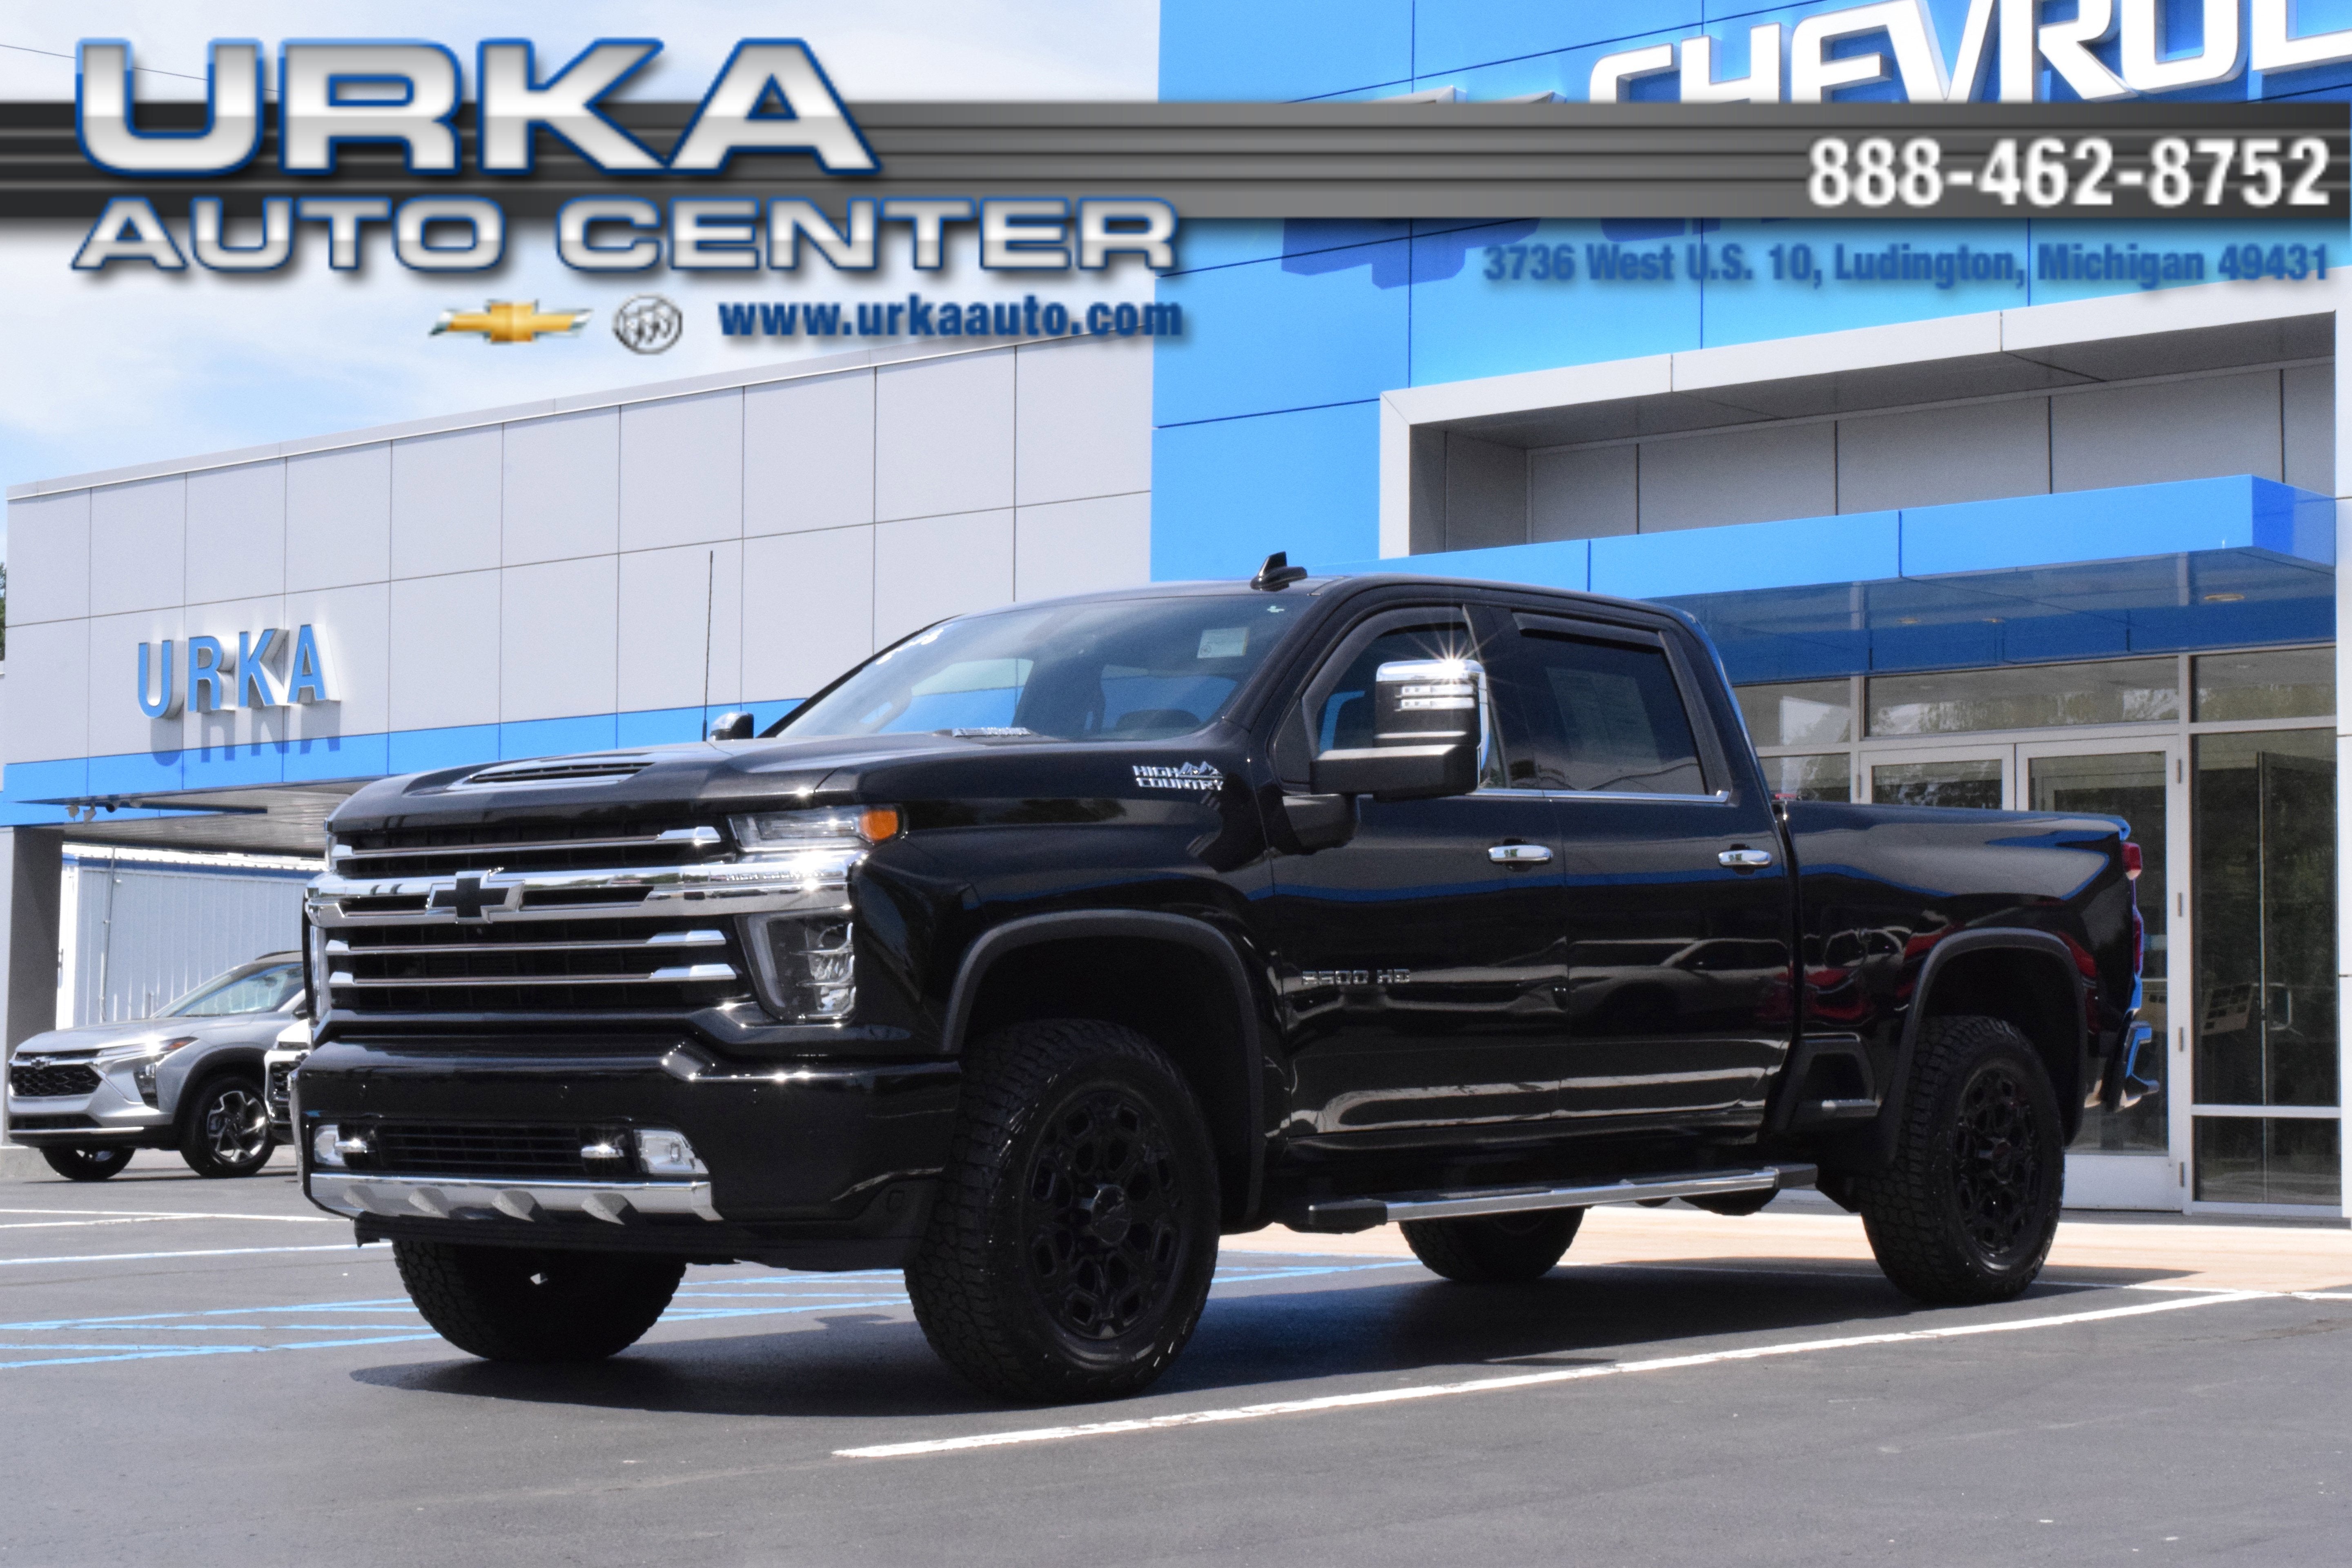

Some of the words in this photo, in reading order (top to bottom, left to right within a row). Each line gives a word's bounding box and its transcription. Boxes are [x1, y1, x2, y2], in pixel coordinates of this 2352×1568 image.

[138, 623, 327, 718] URKA
[1132, 765, 1179, 777] HIGH
[1136, 777, 1224, 791] COUNTRY
[1377, 969, 1410, 983] HD
